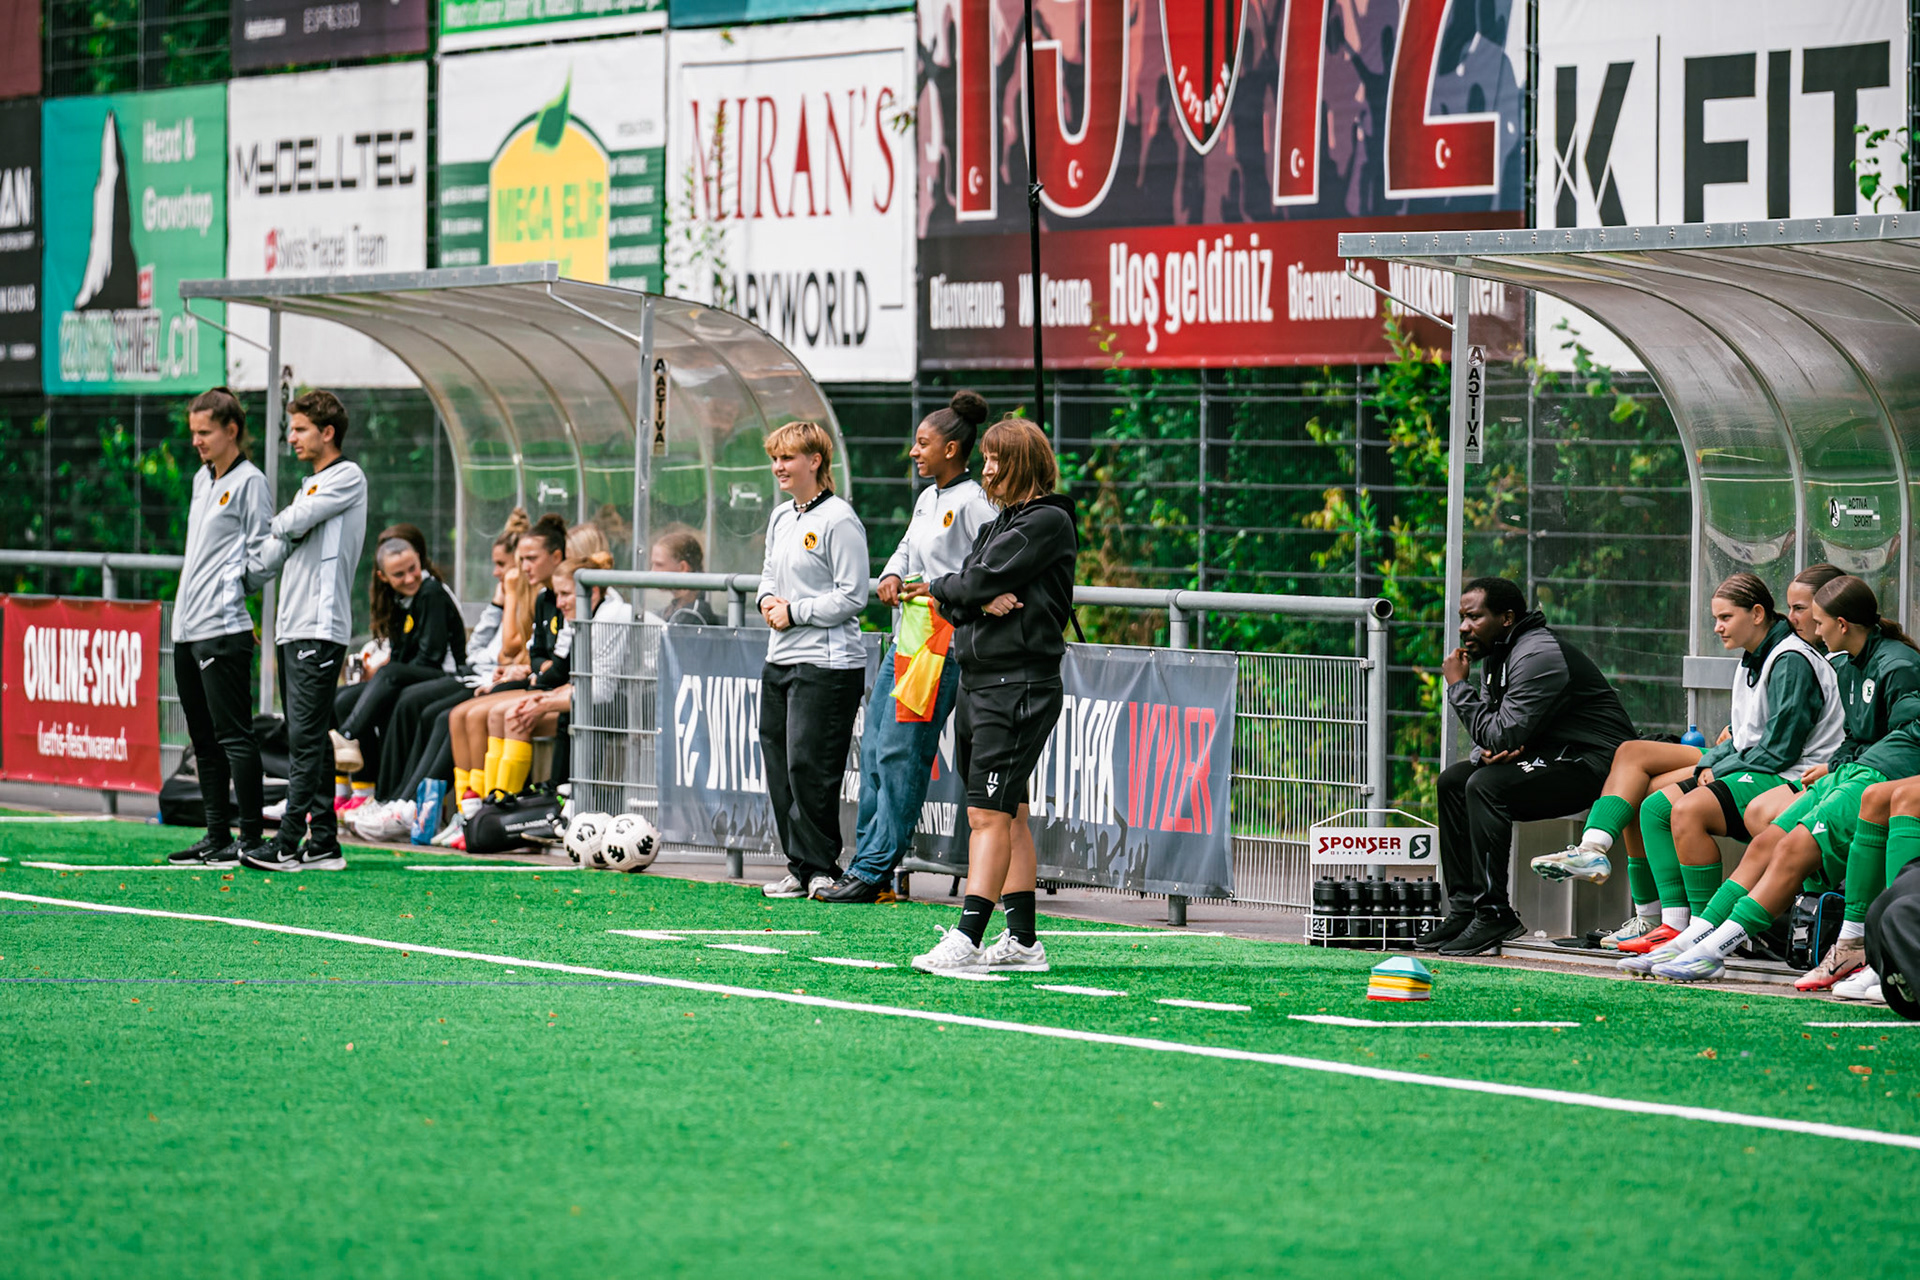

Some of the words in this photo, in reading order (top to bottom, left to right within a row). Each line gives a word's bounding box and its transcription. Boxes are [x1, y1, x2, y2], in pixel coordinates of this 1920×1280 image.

[691, 84, 896, 222] MIRAN'S
[1683, 40, 1890, 224] FIT
[930, 273, 1005, 330] Bienvenue
[1019, 272, 1092, 328] Wlcome
[1110, 242, 1160, 353] Hoş
[1165, 233, 1274, 335] geldiniz
[1287, 261, 1377, 321] Bienvenido
[654, 375, 666, 443] ACTIVA
[674, 674, 703, 788] FC
[987, 771, 999, 785] LL
[1128, 701, 1216, 835] WYLER
[1516, 760, 1535, 773] PM
[1318, 836, 1401, 855] SPONSER
